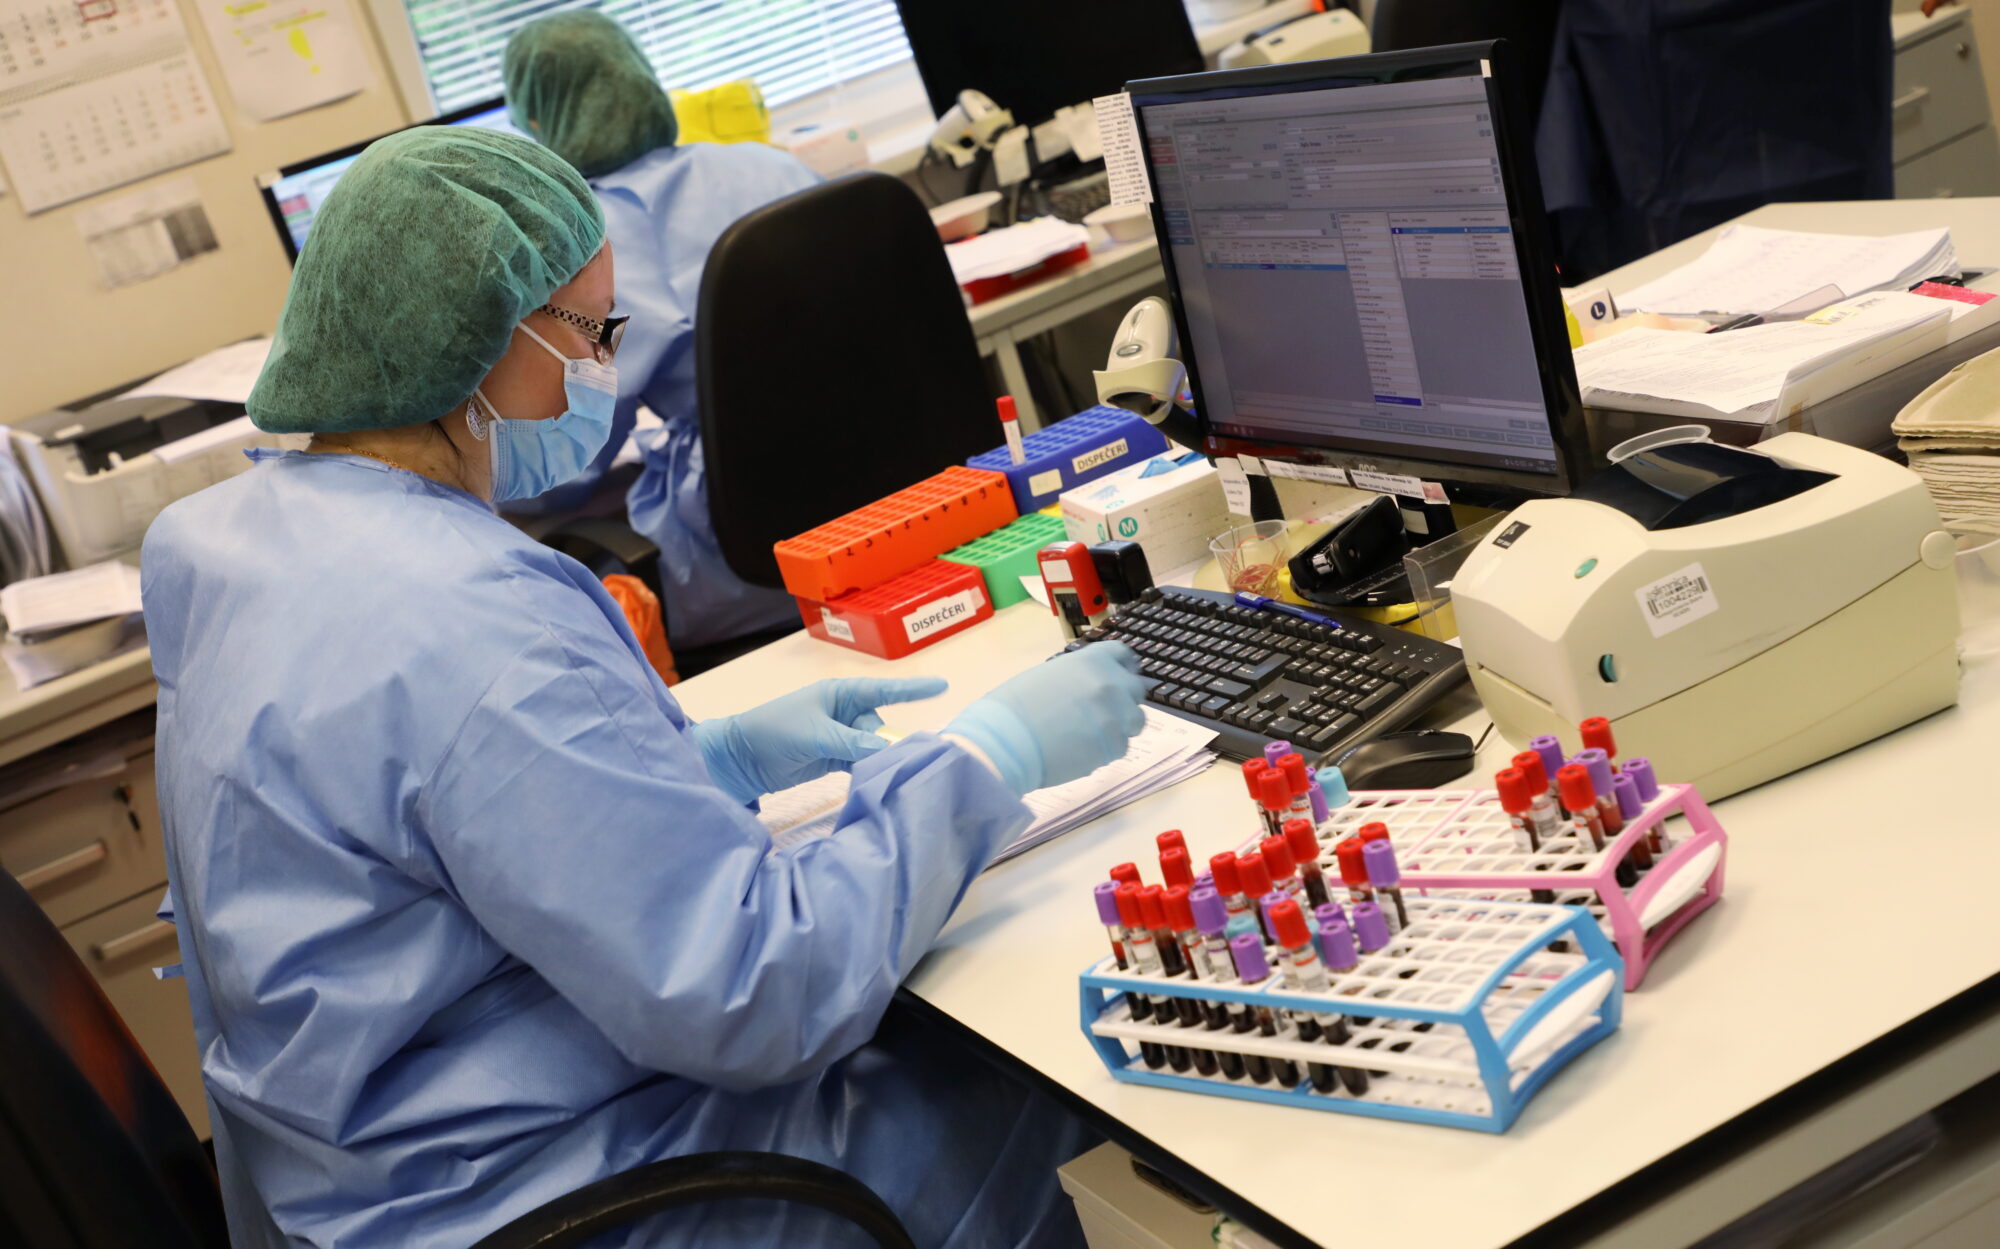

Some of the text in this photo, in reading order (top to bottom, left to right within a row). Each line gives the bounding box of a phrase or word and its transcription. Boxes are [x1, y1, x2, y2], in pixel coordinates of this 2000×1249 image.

[1593, 304, 1604, 317] L
[1077, 443, 1127, 470] DISPEČERI
[1121, 520, 1135, 535] M
[911, 602, 966, 633] DISPEČERI
